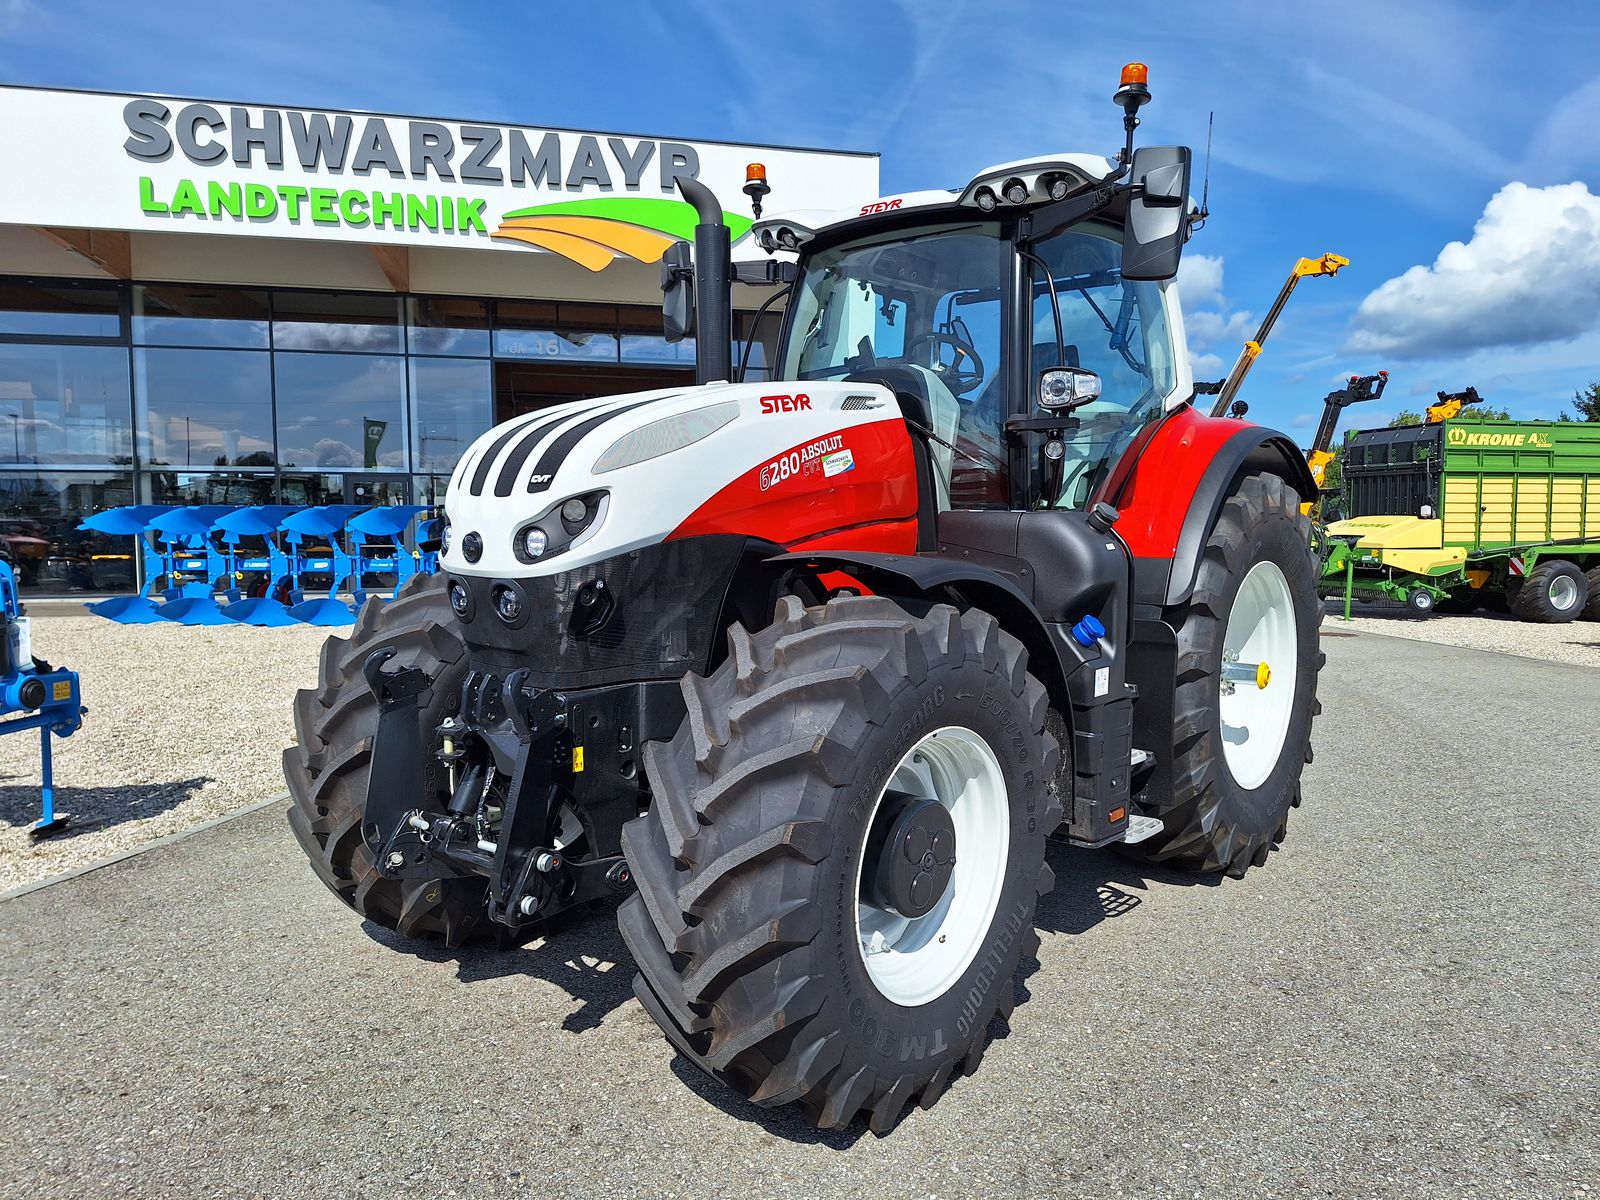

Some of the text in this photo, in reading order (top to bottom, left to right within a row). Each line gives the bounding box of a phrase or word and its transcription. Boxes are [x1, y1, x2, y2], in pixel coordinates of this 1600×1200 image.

[122, 99, 700, 191] SCHWARZMAYR
[139, 177, 487, 236] LANDTECHNIK
[860, 199, 903, 217] STEYR
[760, 393, 813, 414] STEYR
[1467, 432, 1525, 446] KRONE
[531, 474, 553, 484] CVT
[759, 434, 844, 491] 6280 ABSOLUT
[802, 458, 821, 476] CVT
[847, 684, 946, 823] TRELLEBORG
[955, 899, 1031, 1041] TRELLEBORG
